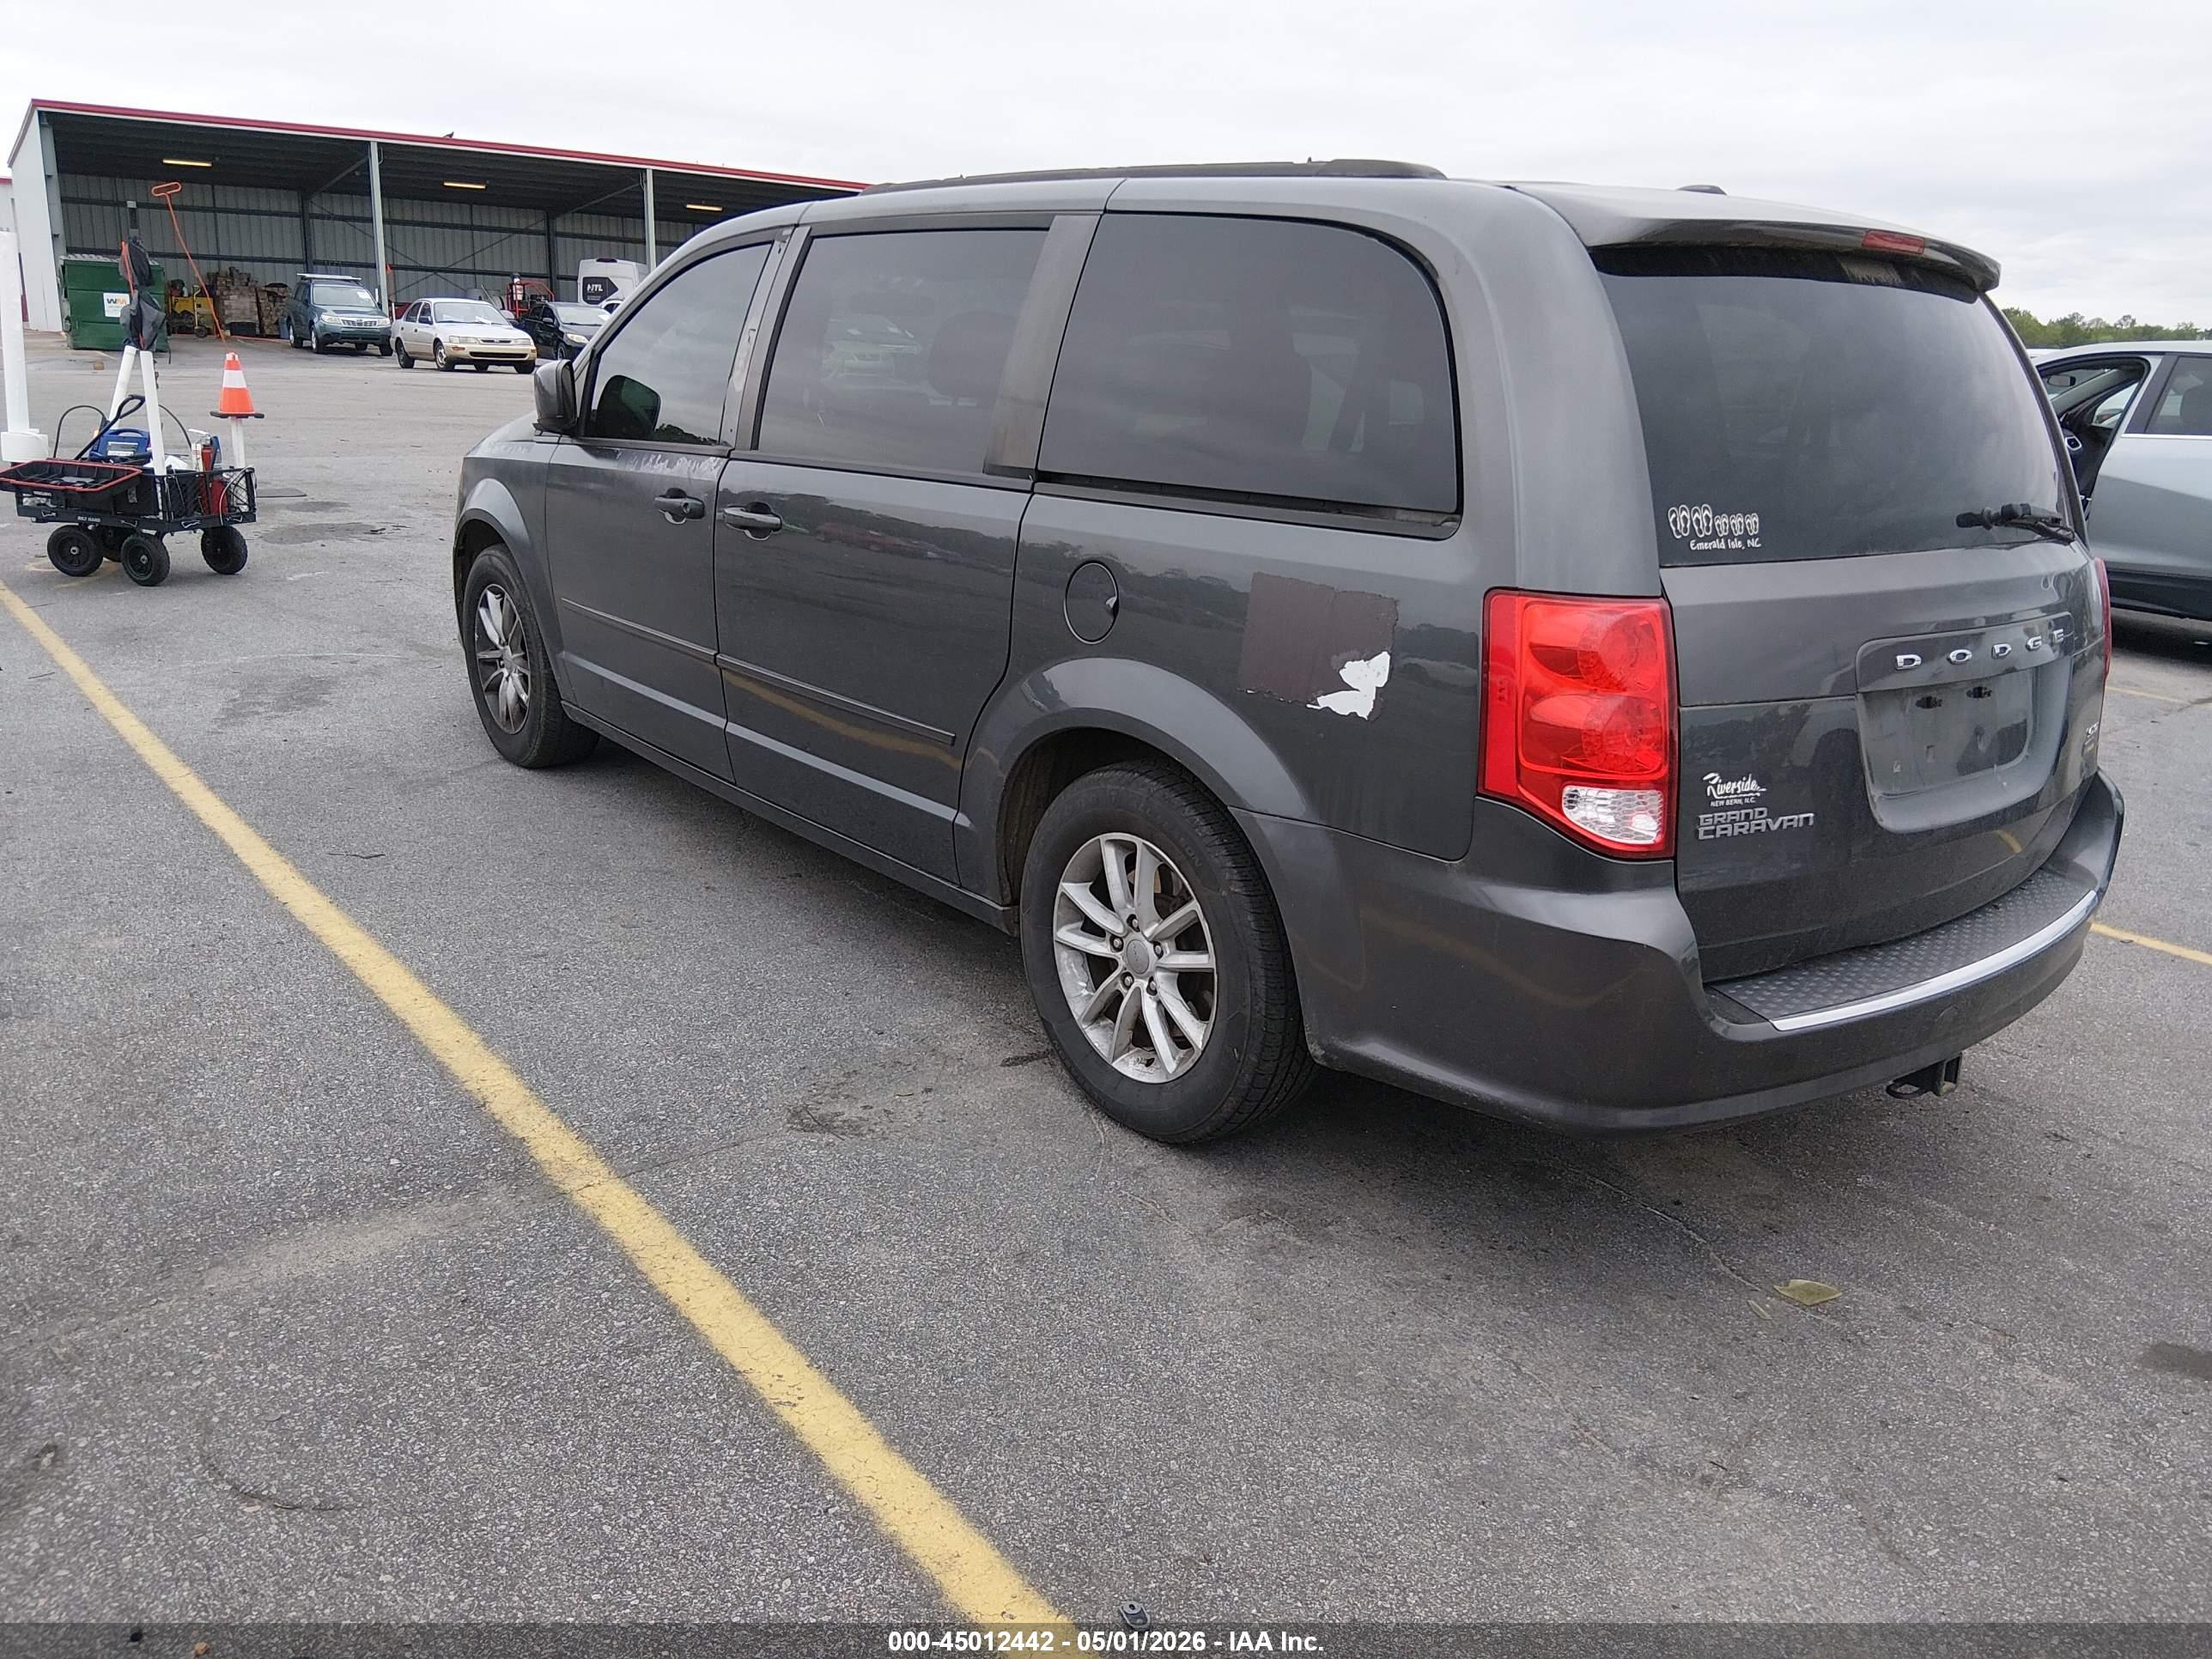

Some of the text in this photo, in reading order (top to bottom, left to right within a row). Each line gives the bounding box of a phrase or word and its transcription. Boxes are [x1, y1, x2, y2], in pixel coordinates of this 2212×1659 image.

[1689, 538, 1762, 550] Emerald Isle, NC
[1894, 628, 2065, 671] DODGE
[1702, 772, 1767, 799] Riverside
[1697, 812, 1814, 841] CARAVAN
[1698, 807, 1768, 826] GRAND
